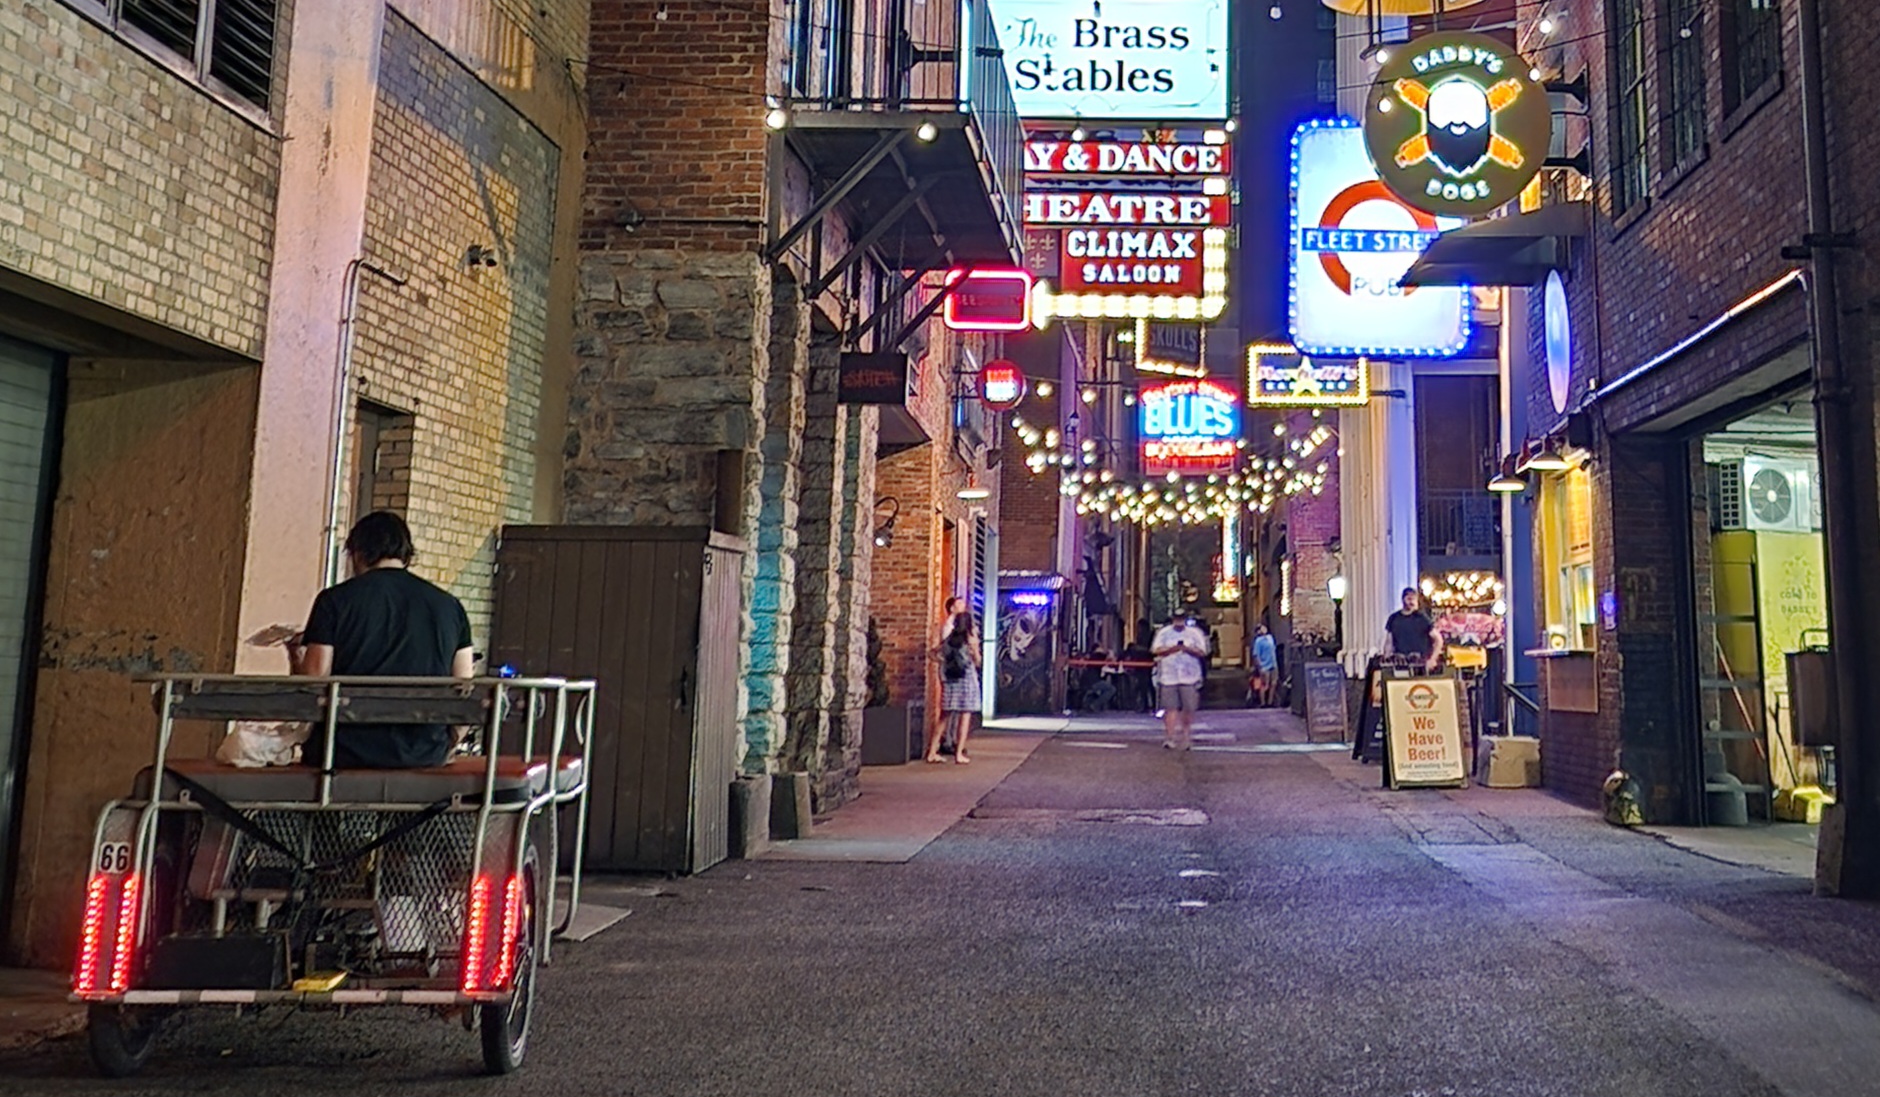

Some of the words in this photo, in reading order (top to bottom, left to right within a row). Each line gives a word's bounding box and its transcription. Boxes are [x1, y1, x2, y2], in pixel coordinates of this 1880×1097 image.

[1010, 16, 1057, 51] The
[1073, 18, 1189, 50] Brass
[1411, 45, 1504, 75] DADDY'S
[1015, 59, 1174, 93] Stables
[1063, 143, 1090, 172] &
[1098, 144, 1223, 172] DANCE
[1024, 194, 1211, 224] HEATRE
[1067, 230, 1197, 259] CLIMAX
[1305, 230, 1368, 250] FLEET
[1373, 232, 1438, 252] STRE
[1082, 264, 1181, 284] SALOON
[1354, 277, 1402, 297] PUB
[1145, 394, 1234, 437] BLUES
[1413, 716, 1436, 731] We
[1408, 732, 1444, 746] Have
[1408, 747, 1447, 761] Beer!
[100, 844, 130, 871] 66
